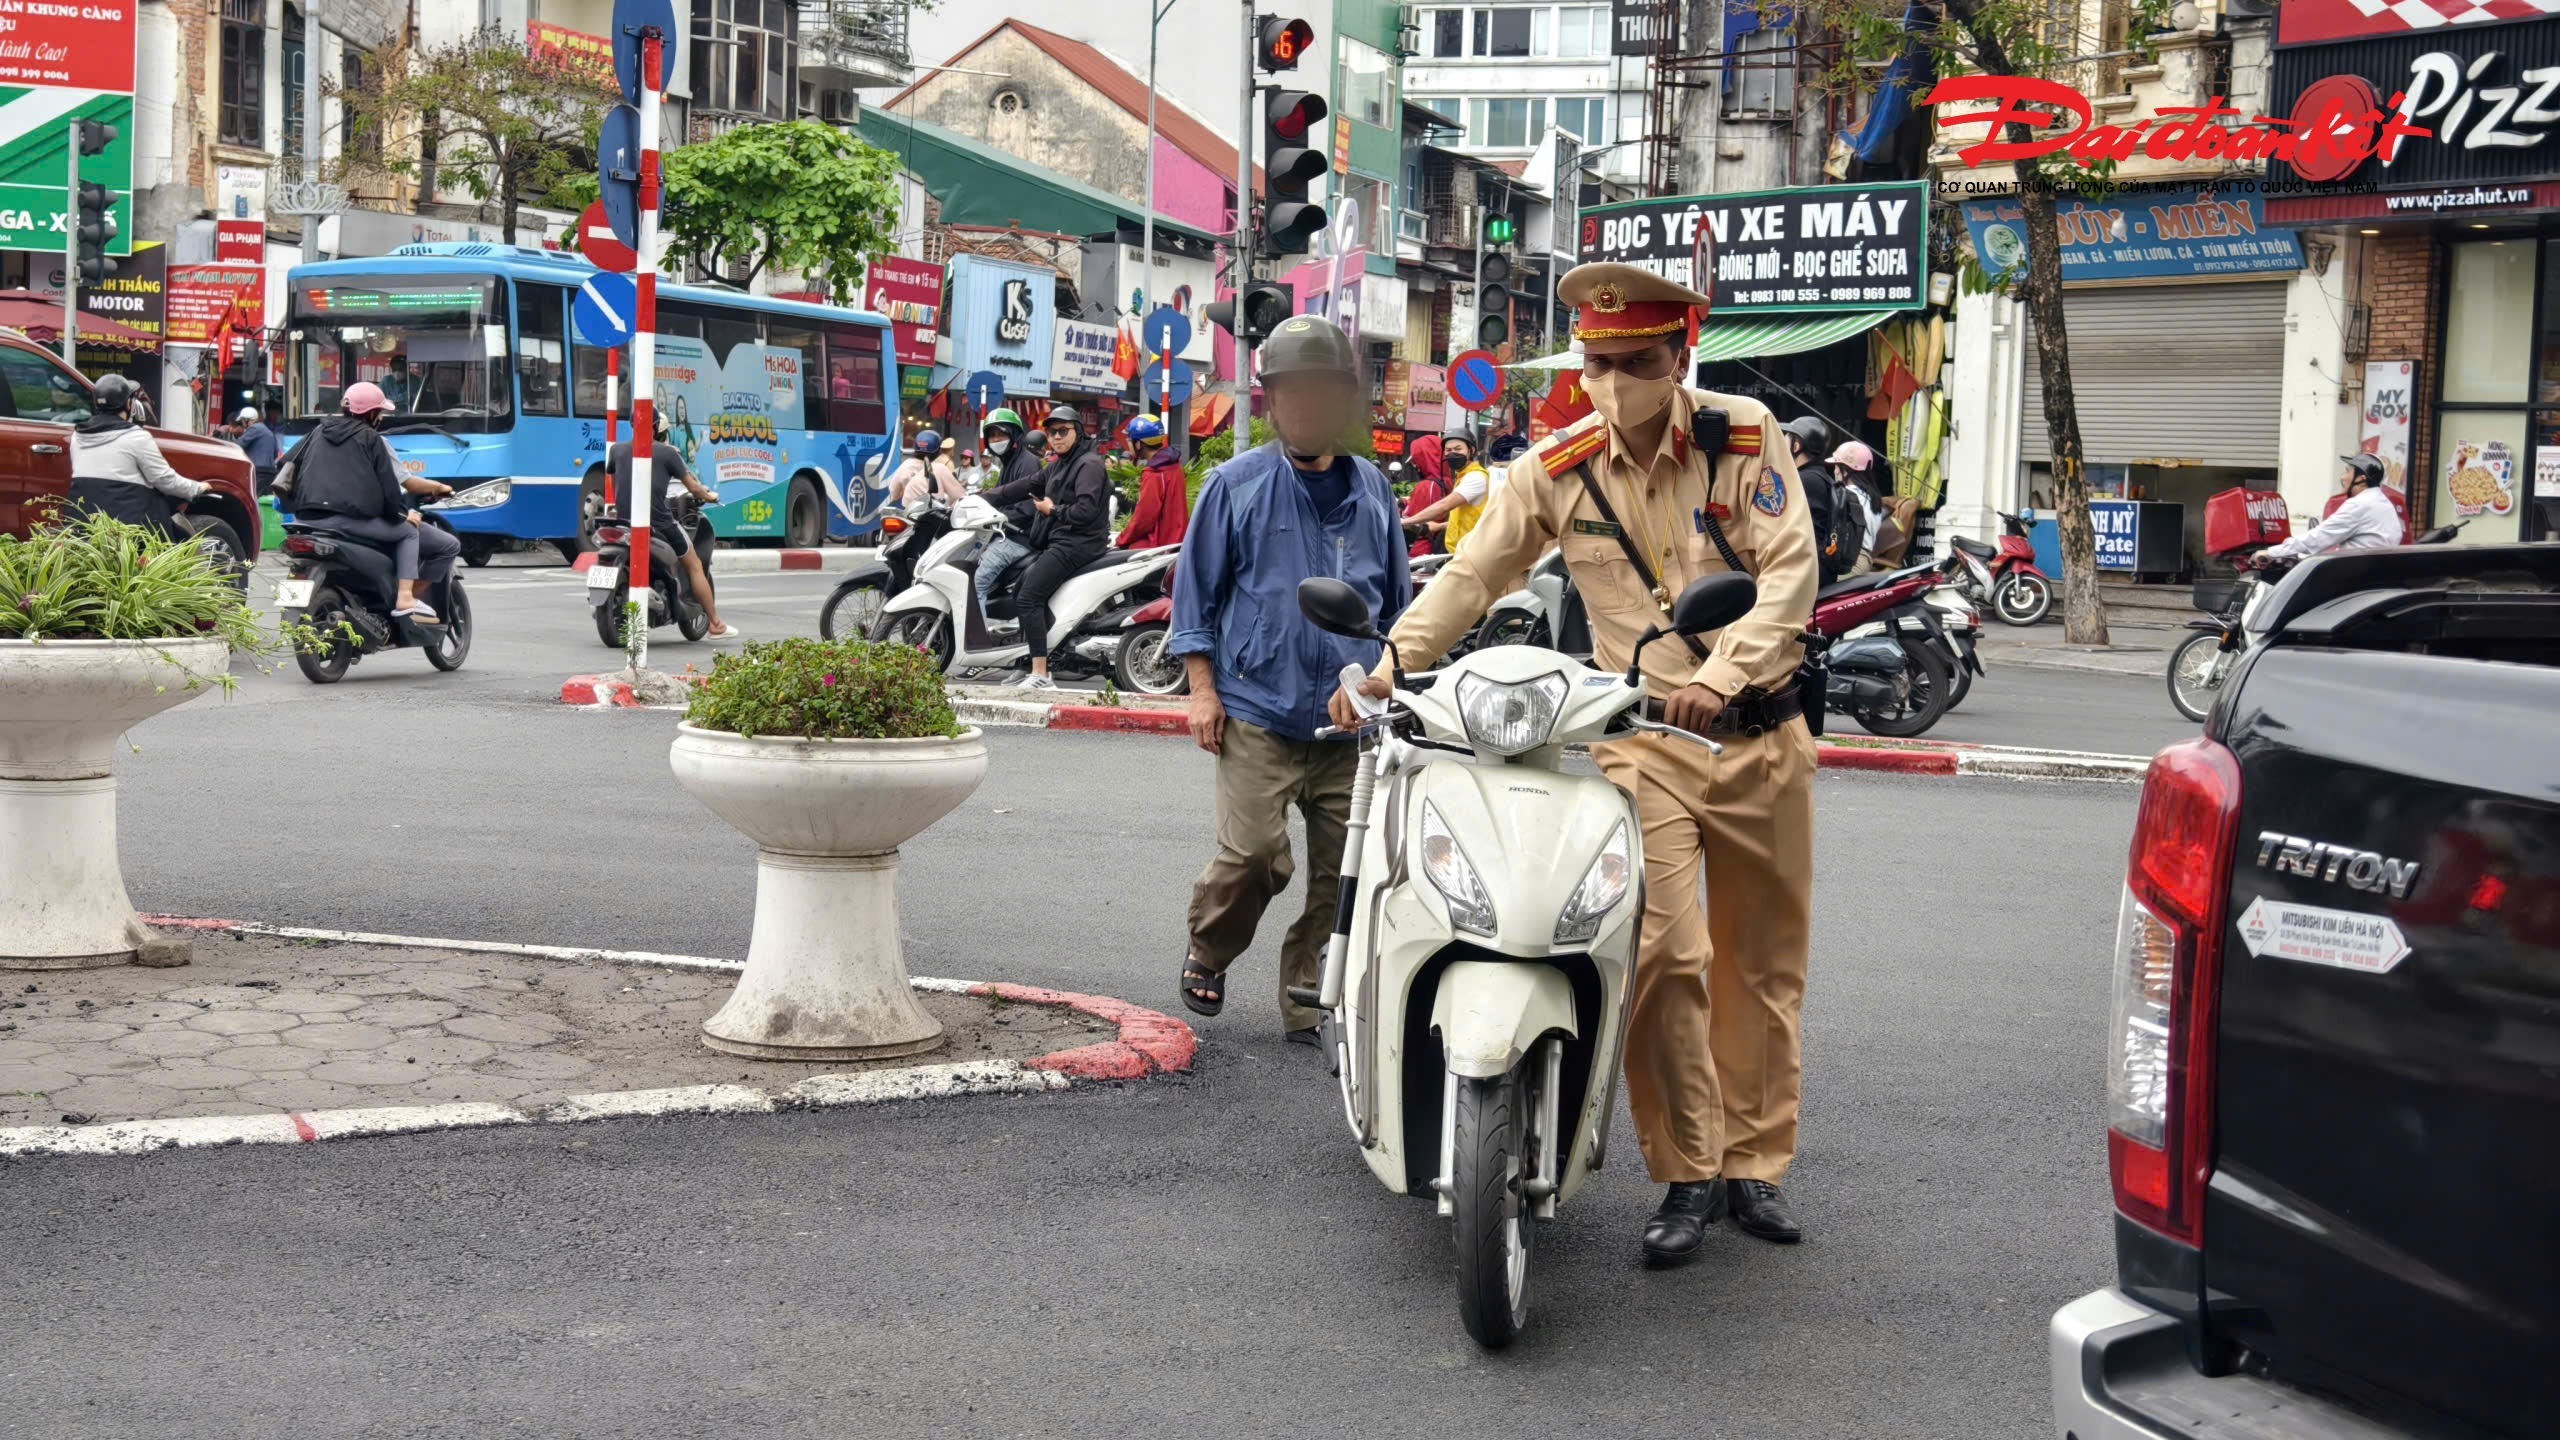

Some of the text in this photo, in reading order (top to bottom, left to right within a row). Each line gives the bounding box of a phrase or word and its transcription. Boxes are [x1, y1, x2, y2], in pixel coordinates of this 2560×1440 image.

[27, 2, 79, 17] KHUNG
[82, 5, 122, 20] CÀNG
[2385, 186, 2529, 212] www.pizzahut.vn
[1602, 193, 1909, 257] BỌC YÊN XE MÁY
[235, 232, 261, 247] PHẠM
[2179, 243, 2195, 260] CÁ
[2202, 242, 2227, 259] BÚN
[2260, 237, 2294, 257] TRỘN
[1719, 249, 1753, 282] ĐÓNG
[1755, 247, 1781, 280] MỚI
[1793, 250, 1826, 284] BỌC
[1830, 240, 1863, 277] GHẾ
[1866, 247, 1909, 277] SOFA
[89, 294, 145, 312] MOTOR
[1733, 290, 1750, 303] Tel:
[1751, 289, 1774, 304] 0983
[1775, 288, 1796, 302] 100
[1797, 287, 1821, 302] 555
[1830, 286, 1861, 301] 0989
[1863, 286, 1886, 300] 969
[1888, 285, 1912, 299] 808
[722, 391, 762, 413] BACK TO
[2375, 388, 2405, 404] MY
[2370, 403, 2408, 419] BOX
[709, 411, 778, 447] SCHOOL
[2112, 503, 2136, 534] MỲ
[2094, 534, 2135, 553] Pate
[2118, 555, 2135, 565] MAI
[1509, 785, 1550, 796] HONDA
[2256, 830, 2421, 899] TRITON
[2281, 911, 2321, 930] MITSUBISHI
[2322, 917, 2337, 932] KIM
[2355, 919, 2367, 937] HÀ
[2368, 920, 2385, 940] NỘI
